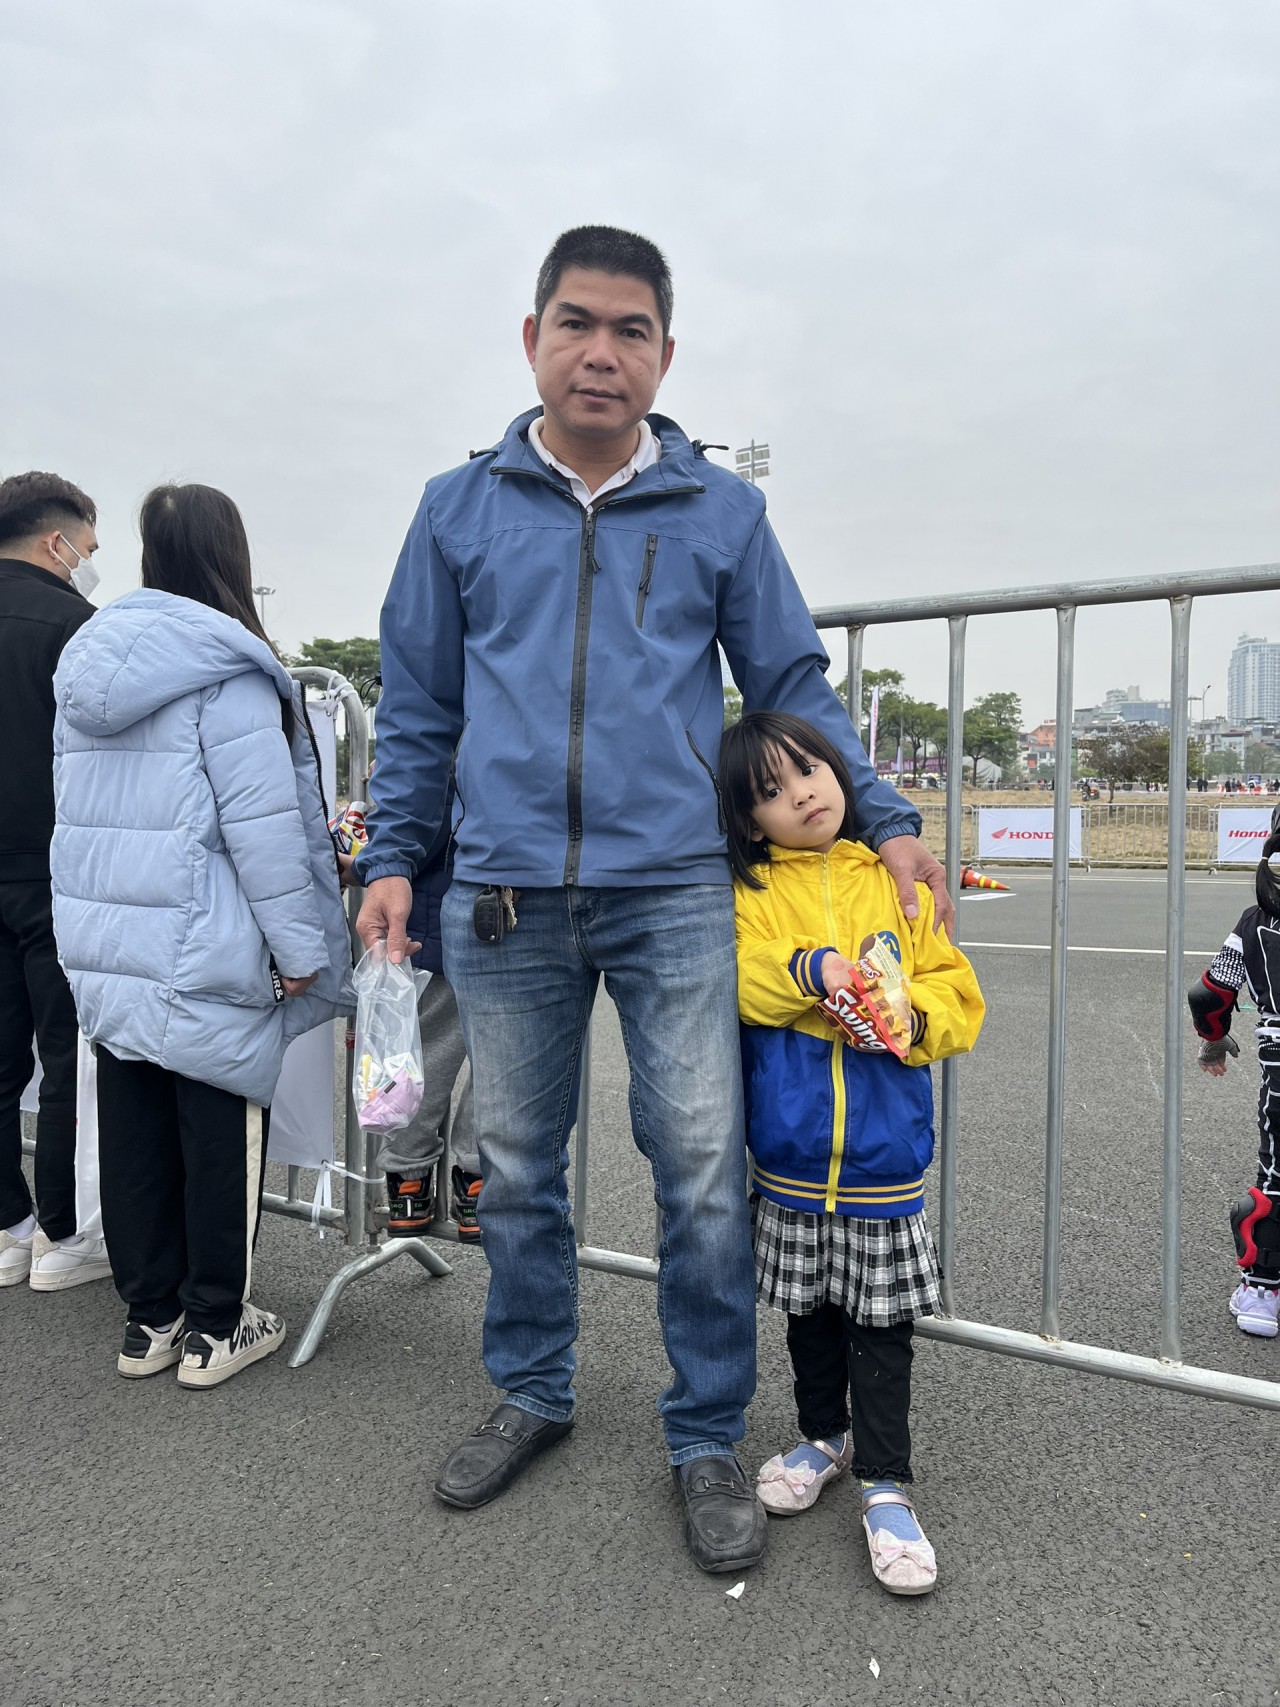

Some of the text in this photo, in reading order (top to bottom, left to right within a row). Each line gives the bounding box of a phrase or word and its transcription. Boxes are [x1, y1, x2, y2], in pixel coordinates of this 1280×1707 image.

[1009, 831, 1054, 839] HOND
[1228, 830, 1271, 838] Hond
[824, 988, 888, 1050] Swing
